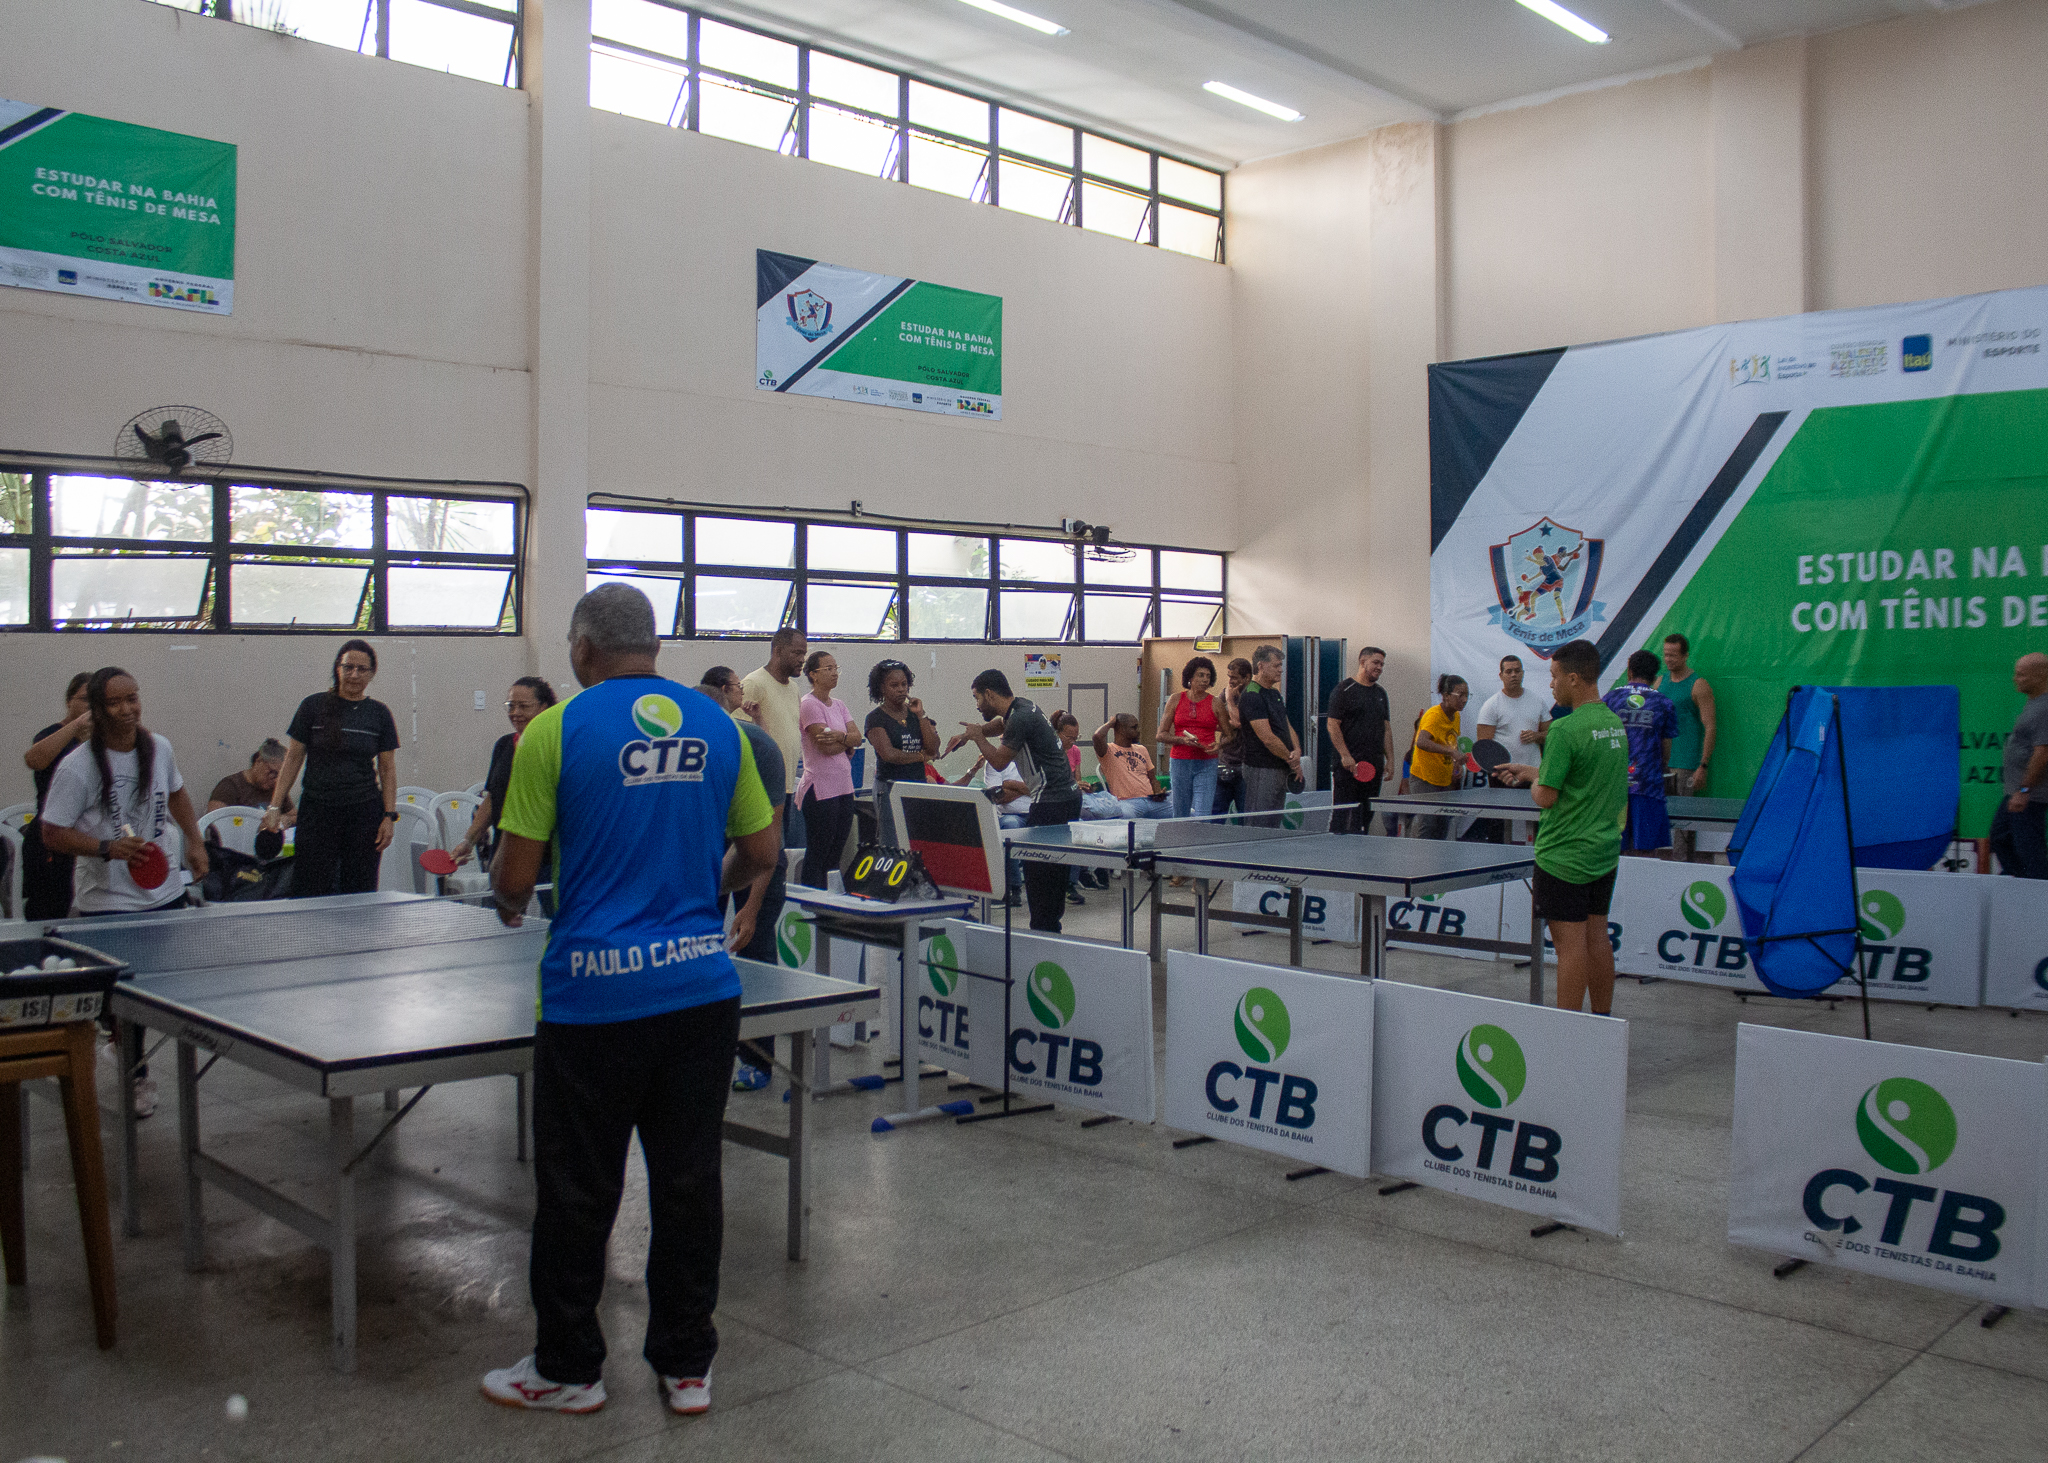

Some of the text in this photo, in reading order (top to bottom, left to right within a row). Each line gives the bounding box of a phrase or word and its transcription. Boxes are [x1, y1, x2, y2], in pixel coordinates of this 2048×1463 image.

[31, 183, 221, 225] COM TÊNIS DE MESA
[34, 167, 219, 210] ESTUDAR NA BAHIA
[86, 244, 162, 264] COSTA AZUL
[109, 237, 173, 254] SALVADOR
[899, 333, 995, 356] COM TÊNIS DE MESA
[901, 321, 993, 345] ESTUDAR NA BAHIA
[936, 367, 970, 378] SALVADOR
[1903, 352, 1932, 368] Itaú
[759, 378, 777, 387] CTB
[925, 374, 948, 383] COSTA
[1797, 548, 1957, 586] ESTUDAR
[1971, 545, 2028, 579] NA
[1791, 587, 2048, 633] COM TÊNIS DE
[1507, 620, 1586, 642] Tênis de Mesa
[1617, 708, 1655, 724] CTB
[620, 738, 707, 777] CTB
[854, 856, 874, 880] 0
[888, 861, 908, 886] 0
[1018, 849, 1051, 861] Hobby
[1248, 873, 1290, 884] Hobby
[1388, 900, 1467, 937] CTB
[570, 946, 645, 978] PAULO
[1657, 929, 1748, 970] CTB
[1856, 944, 1933, 983] TB
[1008, 1028, 1104, 1086] CTB
[1010, 1073, 1104, 1099] CLUBE DOS TENISTAS DA BAHIA
[1205, 1060, 1319, 1130] CTB
[1206, 1111, 1314, 1144] CLUBE DOS TENISTAS DA BAHIA
[1421, 1104, 1562, 1184] CTB
[1423, 1159, 1557, 1200] CLUBE DOS TENISTAS DA BAHIA
[1802, 1168, 2007, 1263] CTB
[1845, 1239, 1871, 1255] DOS
[1873, 1246, 1933, 1268] TENISTAS
[1935, 1260, 1953, 1273] DA
[1956, 1264, 1997, 1283] BAHIA
